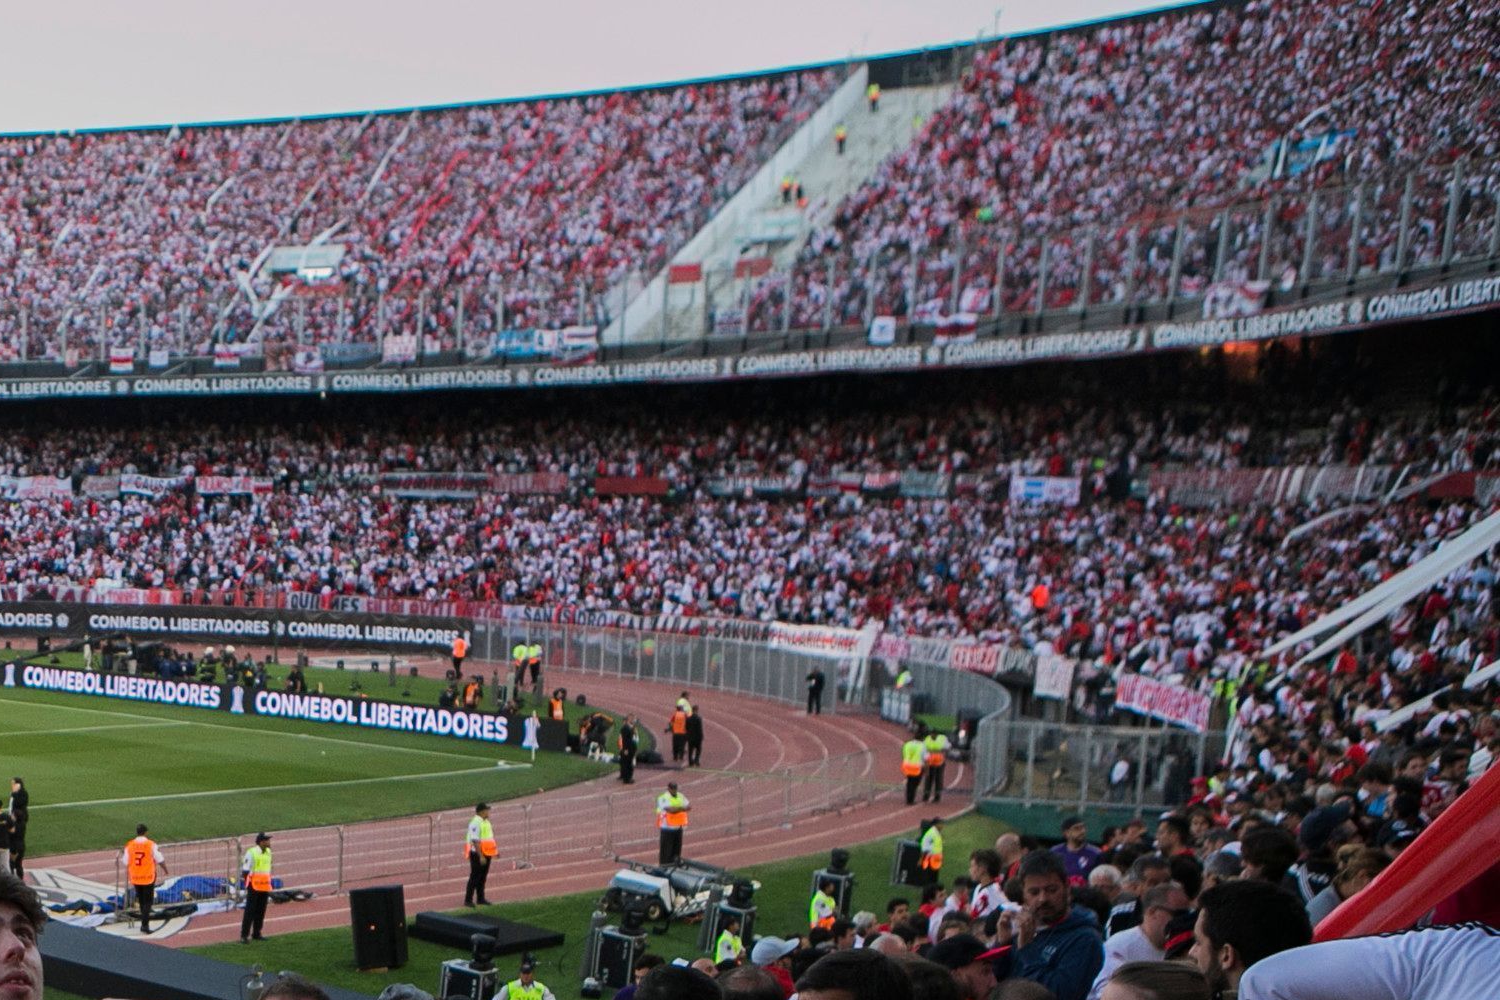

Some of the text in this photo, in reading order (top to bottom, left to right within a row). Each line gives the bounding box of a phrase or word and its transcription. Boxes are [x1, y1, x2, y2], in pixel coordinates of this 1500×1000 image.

[1367, 285, 1449, 322] CONMEBOL
[534, 358, 717, 383] CONMEBOL LIBERTADORES
[736, 345, 922, 374] CONMEBOL LIBERTADORES
[12, 380, 112, 395] LIBERTADORES
[134, 376, 312, 392] CONMEBOL LIBERTADORES
[332, 370, 512, 388] CONMEBOL LIBERTADORES
[88, 614, 270, 636] CONMEBOL LIBERTADORES
[287, 620, 460, 647] CONMEBOL LIBERTADORES
[22, 664, 222, 709] CONMEBOL LIBERTADORES
[255, 689, 509, 744] CONMEBOL LIBERTADORES
